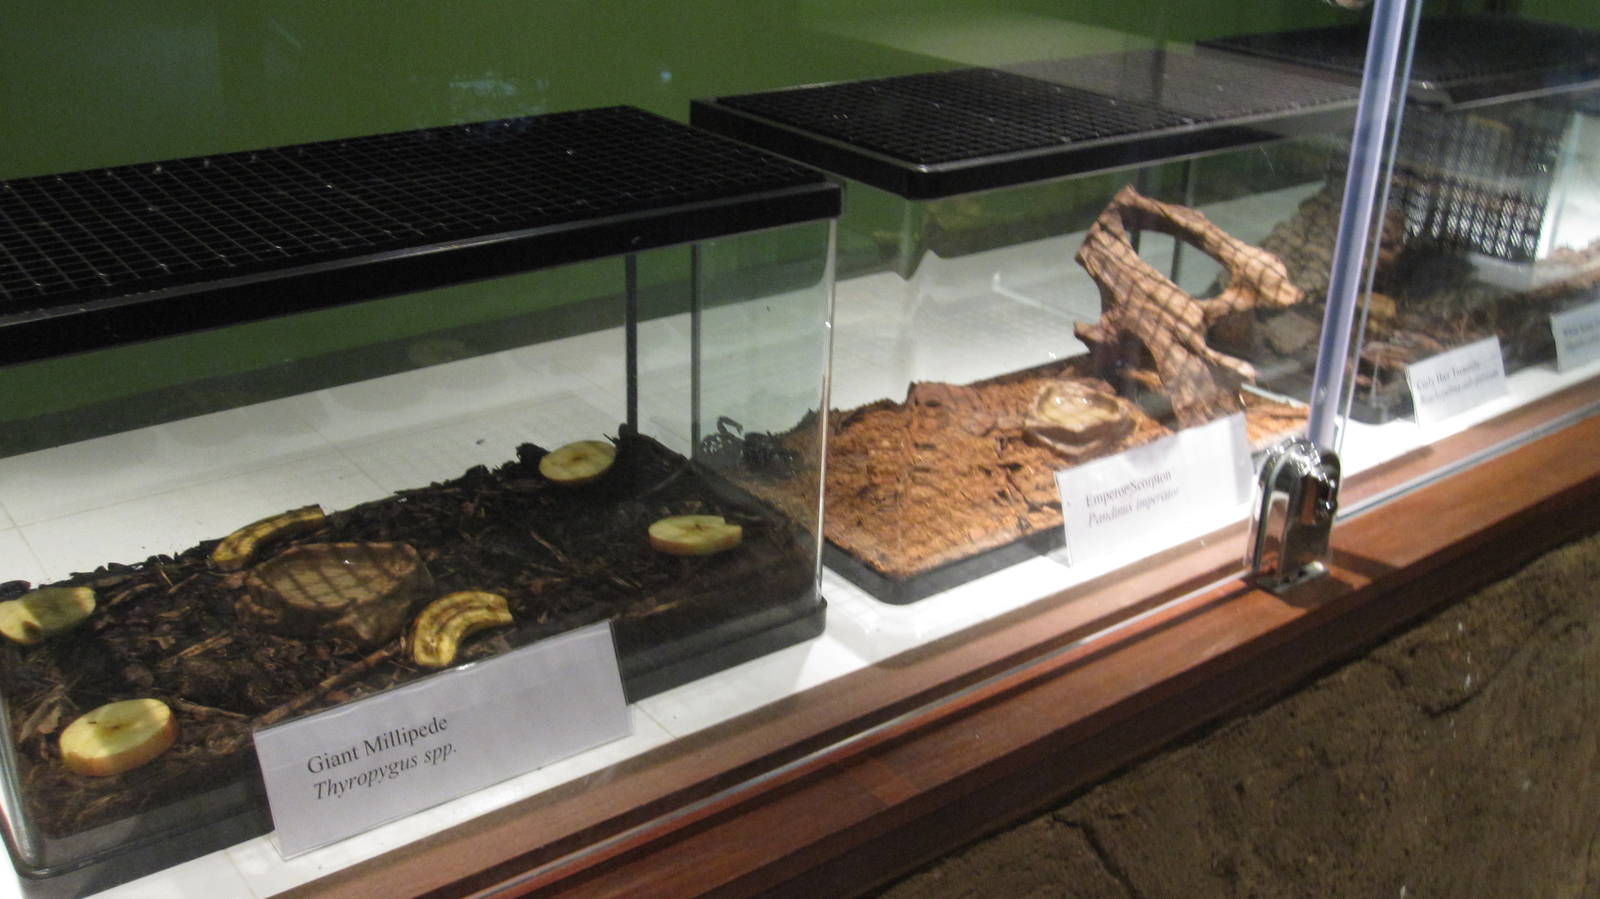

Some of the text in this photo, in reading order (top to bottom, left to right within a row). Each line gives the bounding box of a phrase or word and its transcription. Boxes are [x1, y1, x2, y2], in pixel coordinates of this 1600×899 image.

[1085, 471, 1172, 508] Emperor Scorpion
[307, 716, 448, 774] Giant Millipede
[314, 742, 457, 800] Thyropygus spp.
